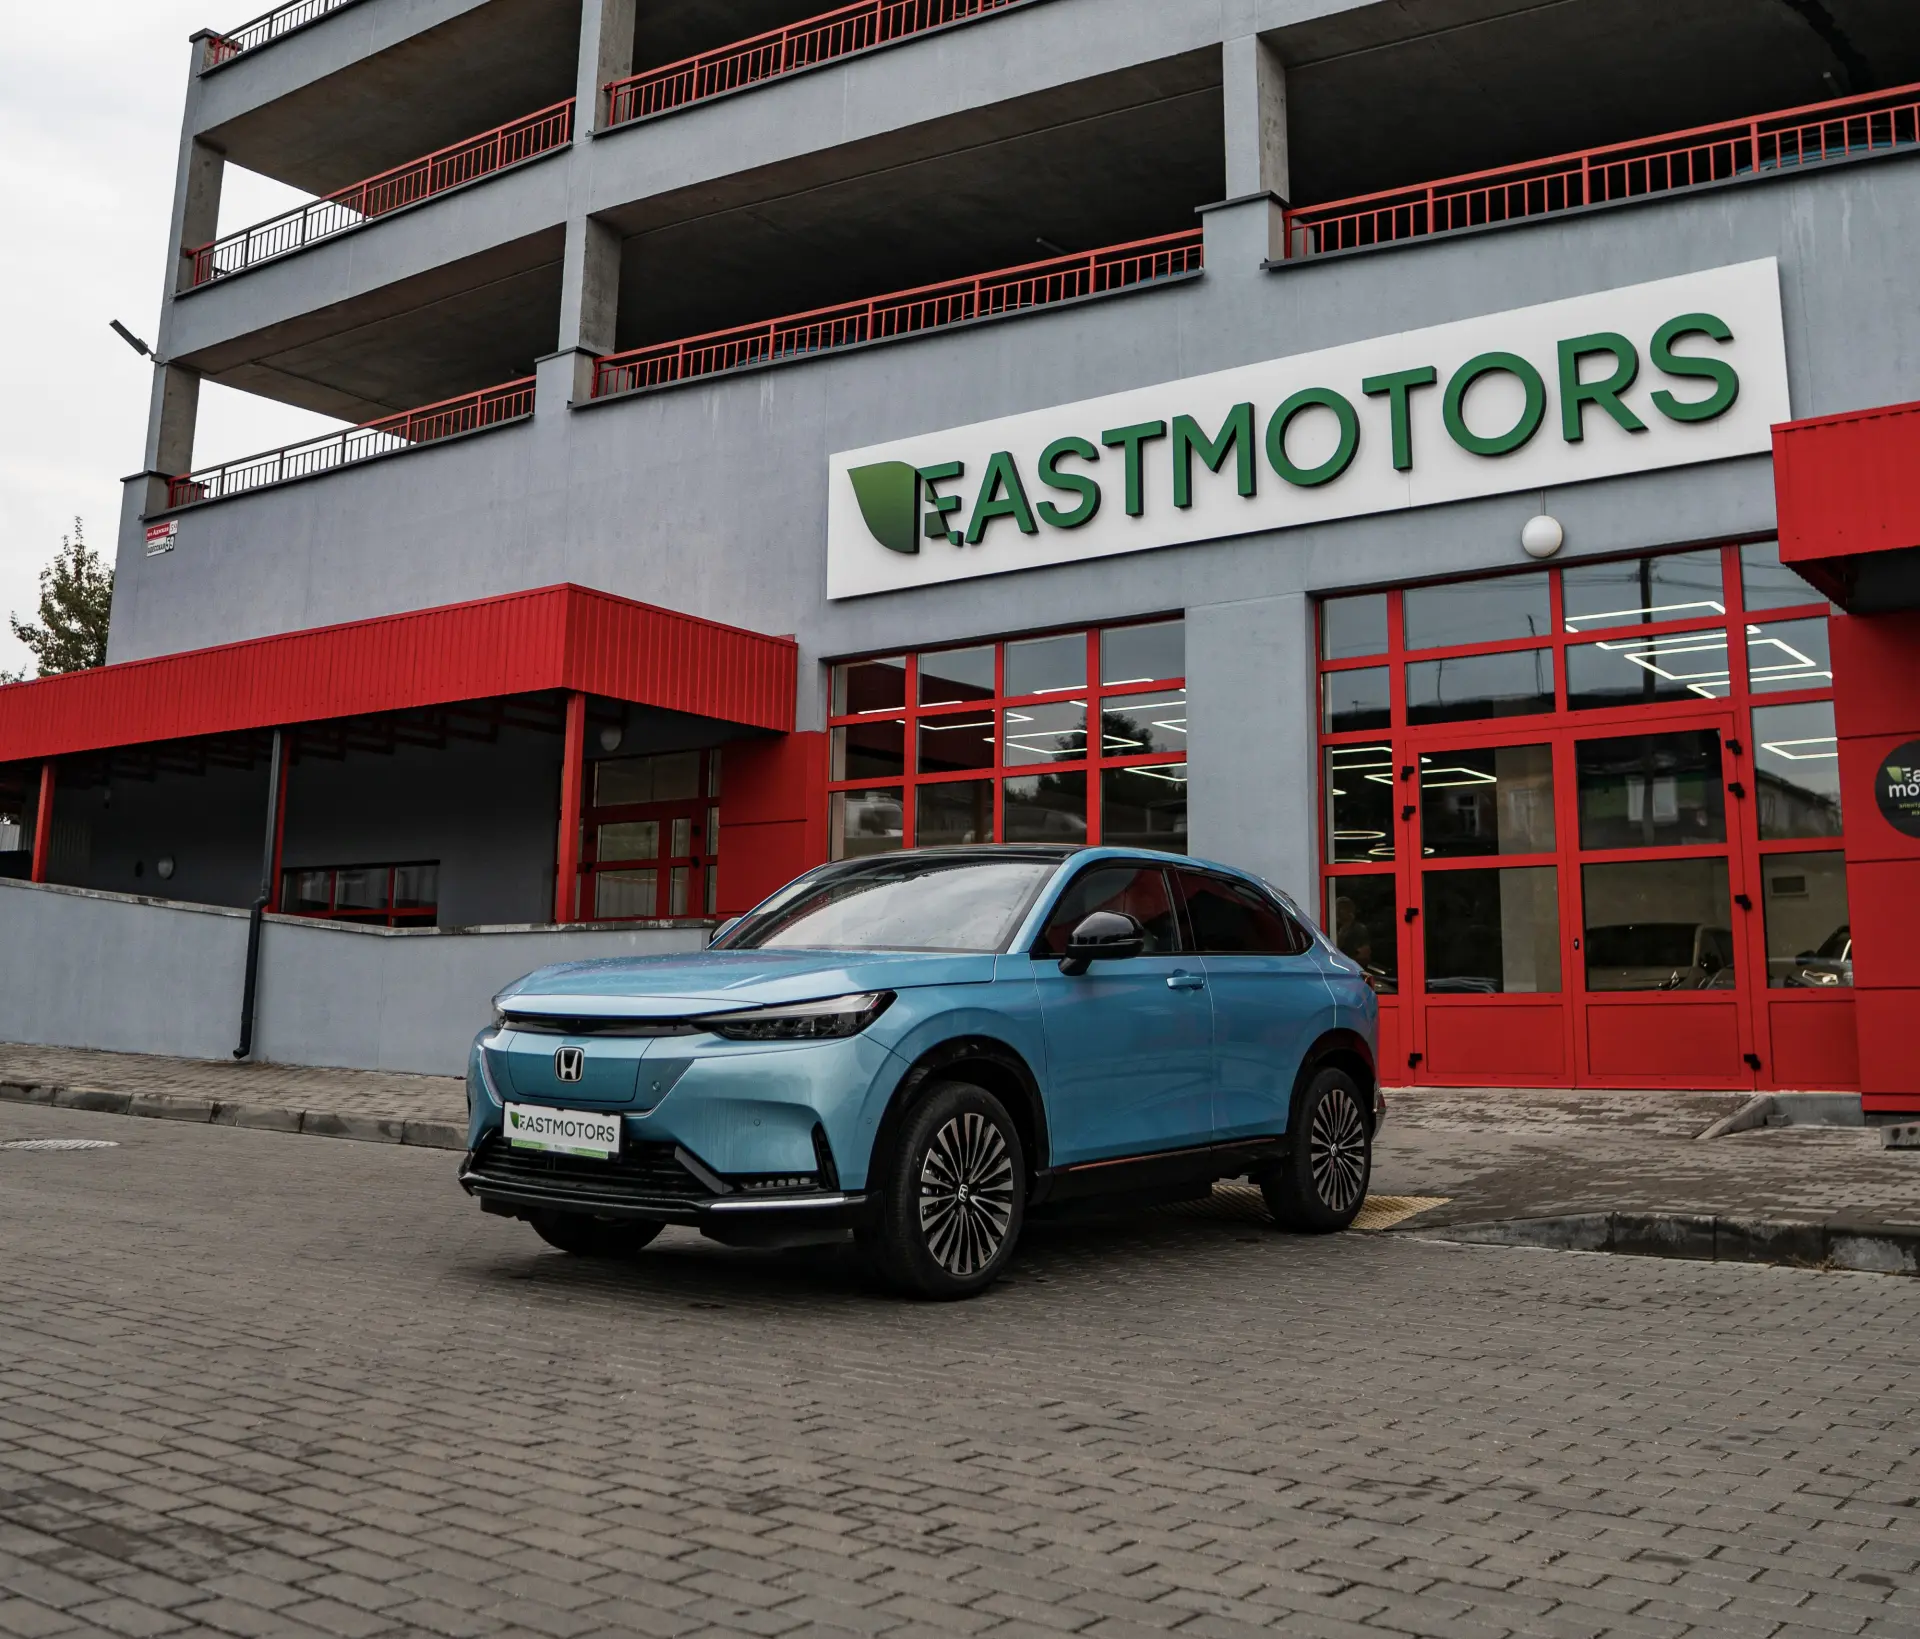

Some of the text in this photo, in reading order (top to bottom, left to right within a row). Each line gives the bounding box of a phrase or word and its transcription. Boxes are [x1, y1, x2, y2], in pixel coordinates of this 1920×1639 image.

[919, 312, 1740, 547] EASTMOTORS
[166, 536, 174, 550] 59
[1889, 783, 1920, 798] mo
[520, 1115, 615, 1143] EASTMOTORS
